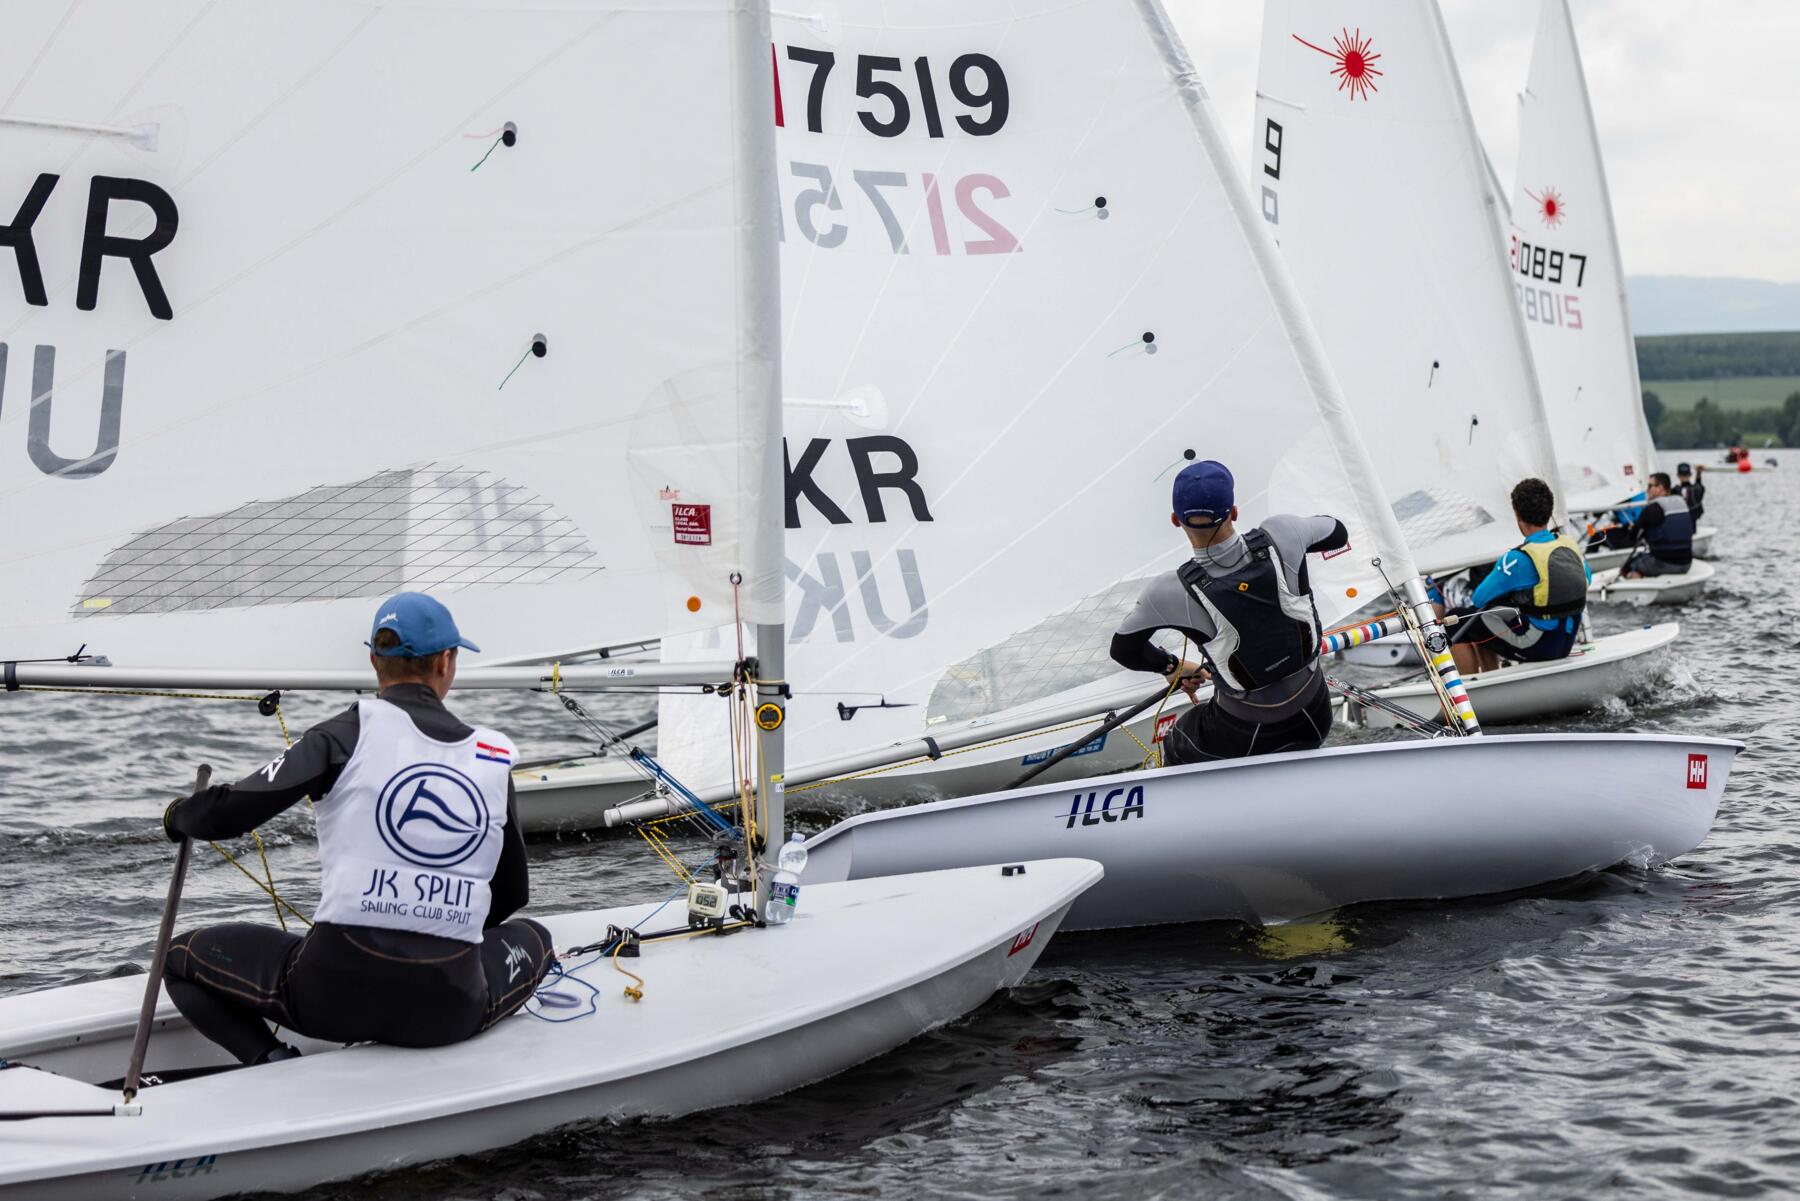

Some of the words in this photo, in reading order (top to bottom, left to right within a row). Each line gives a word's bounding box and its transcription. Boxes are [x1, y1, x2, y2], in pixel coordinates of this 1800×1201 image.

[675, 507, 695, 516] ILCA
[1066, 785, 1144, 829] ILCA
[363, 869, 399, 898] JK
[414, 873, 475, 908] SPLIT
[360, 899, 409, 916] SAILING
[412, 905, 443, 920] CLUB
[445, 909, 473, 925] SPLIT
[135, 1154, 217, 1185] ILCA
